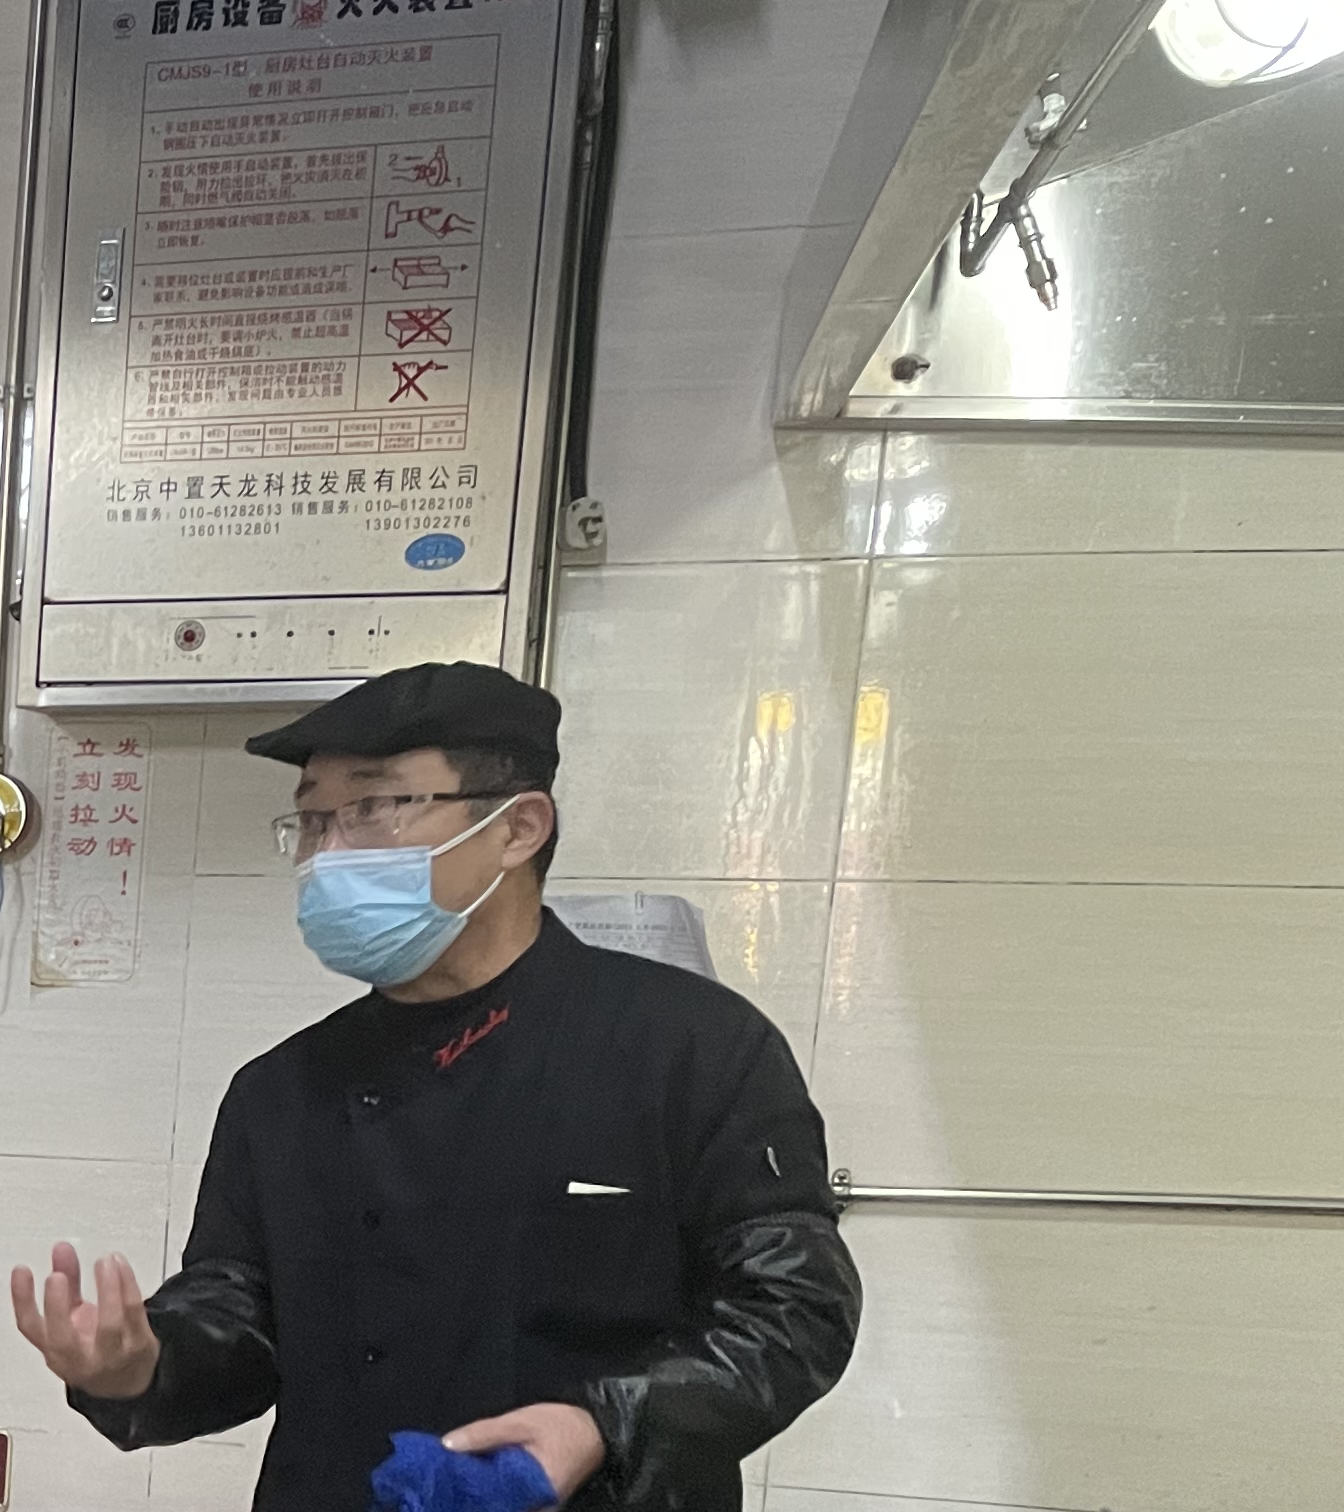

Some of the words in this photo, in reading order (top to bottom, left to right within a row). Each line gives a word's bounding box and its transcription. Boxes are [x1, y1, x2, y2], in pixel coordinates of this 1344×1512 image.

[106, 464, 479, 503] 北京中置天龙科技发展有限公司
[179, 503, 282, 520] 010-61282613
[365, 497, 473, 513] 010-61282108
[180, 521, 280, 537] 13601132801
[365, 515, 472, 531] 13901302276
[67, 738, 104, 857] 立刻拉动
